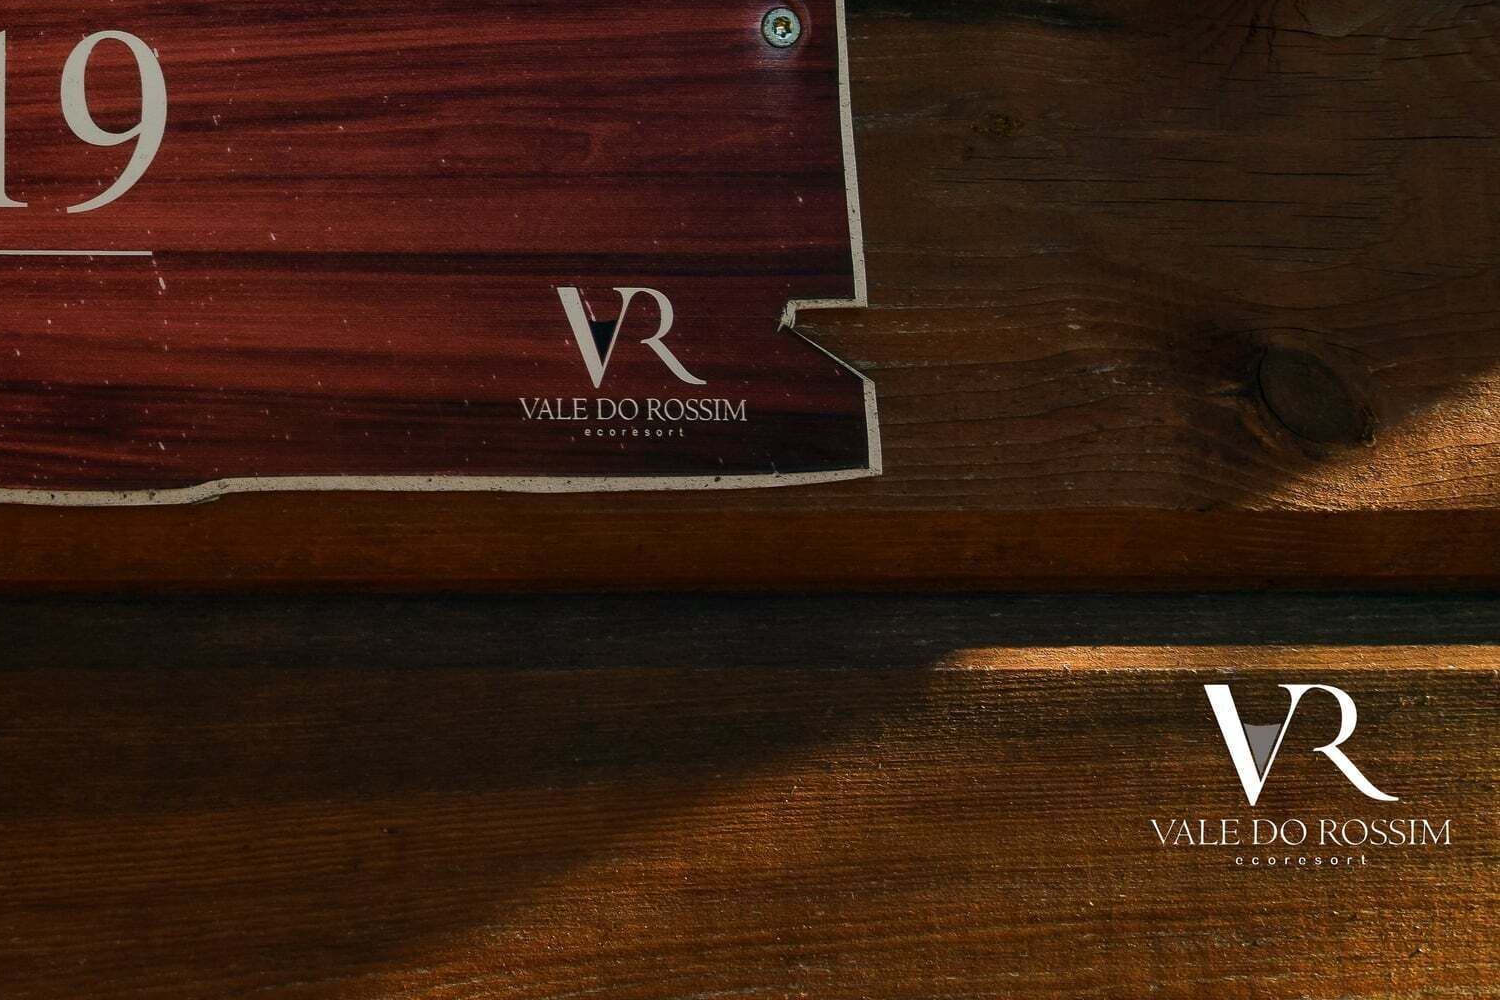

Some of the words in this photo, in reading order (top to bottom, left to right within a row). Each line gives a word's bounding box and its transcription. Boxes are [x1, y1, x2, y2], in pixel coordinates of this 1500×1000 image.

[556, 286, 708, 389] VR
[518, 397, 589, 421] VALE
[595, 397, 639, 422] DO
[645, 397, 749, 423] ROSSIM
[583, 427, 685, 438] ecoresort
